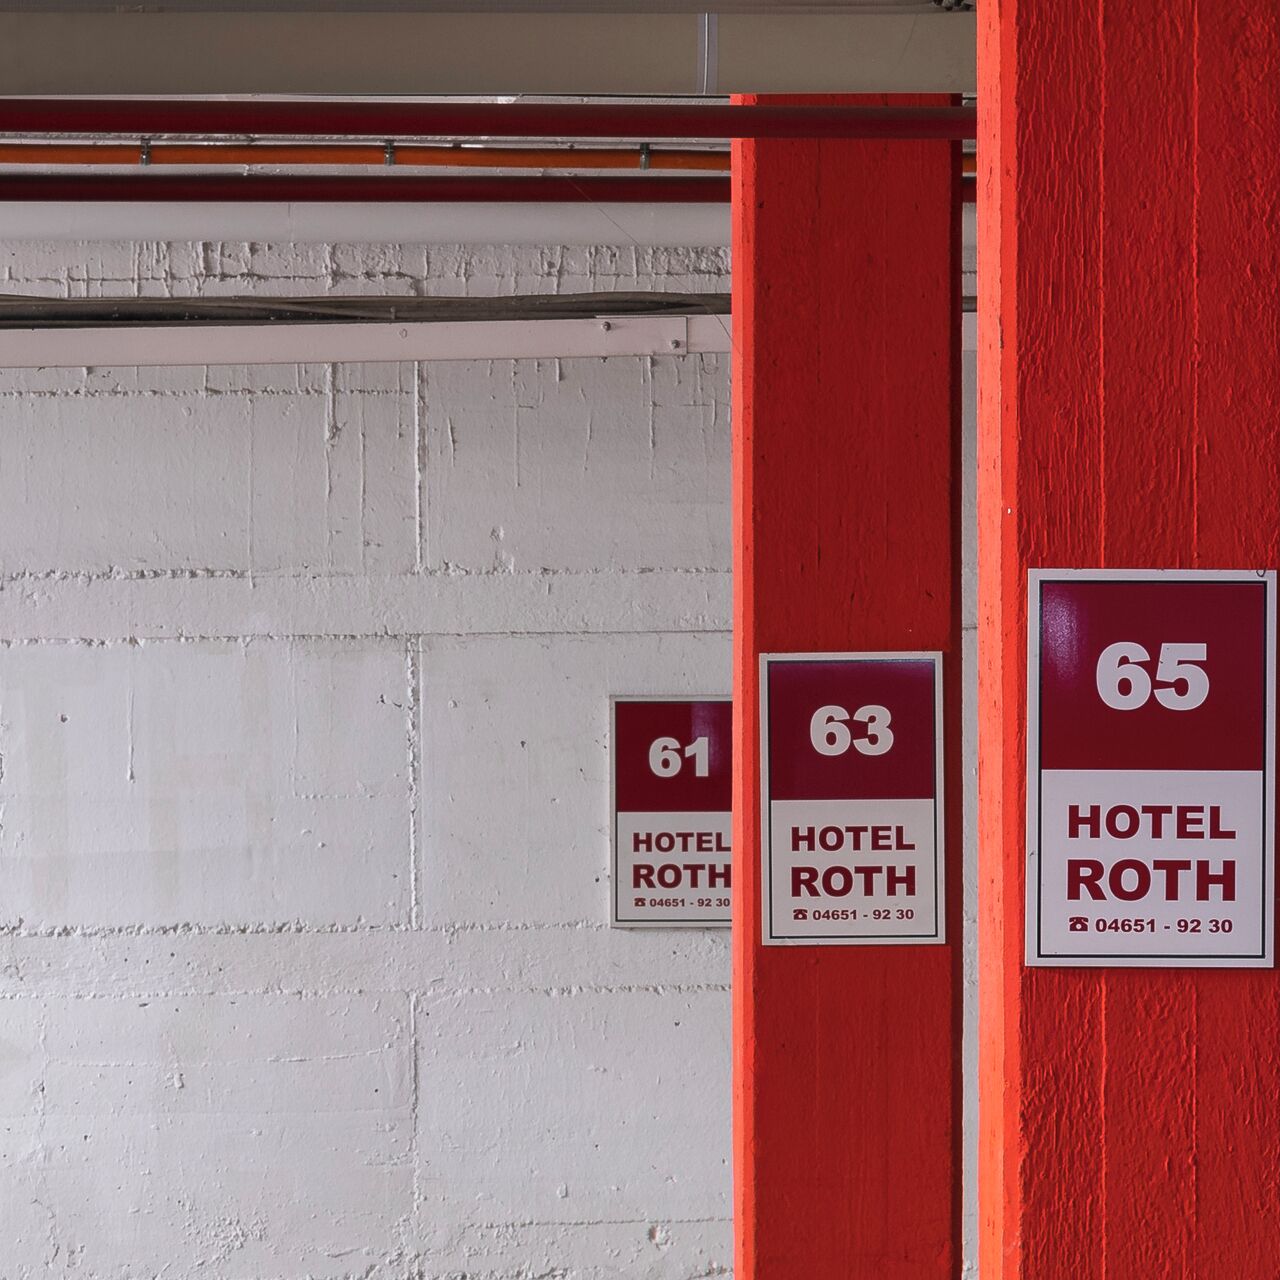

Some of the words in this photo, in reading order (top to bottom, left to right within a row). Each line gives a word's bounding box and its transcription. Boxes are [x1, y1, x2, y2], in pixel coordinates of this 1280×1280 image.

[1096, 642, 1209, 710] 65
[810, 705, 894, 756] 63
[649, 737, 708, 777] 61
[1069, 805, 1236, 839] HOTEL
[633, 832, 731, 852] HOTEL
[792, 826, 915, 851] HOTEL
[633, 864, 731, 888] ROTH
[792, 866, 915, 897] ROTH
[1068, 859, 1235, 901] ROTH
[650, 899, 684, 907] 04651
[698, 898, 711, 907] 92
[716, 898, 730, 907] 30
[813, 910, 856, 920] 04651
[873, 909, 890, 919] 92
[896, 909, 914, 919] 30
[1096, 919, 1154, 932] 04651
[1177, 919, 1201, 932] 92
[1209, 919, 1232, 933] 30
